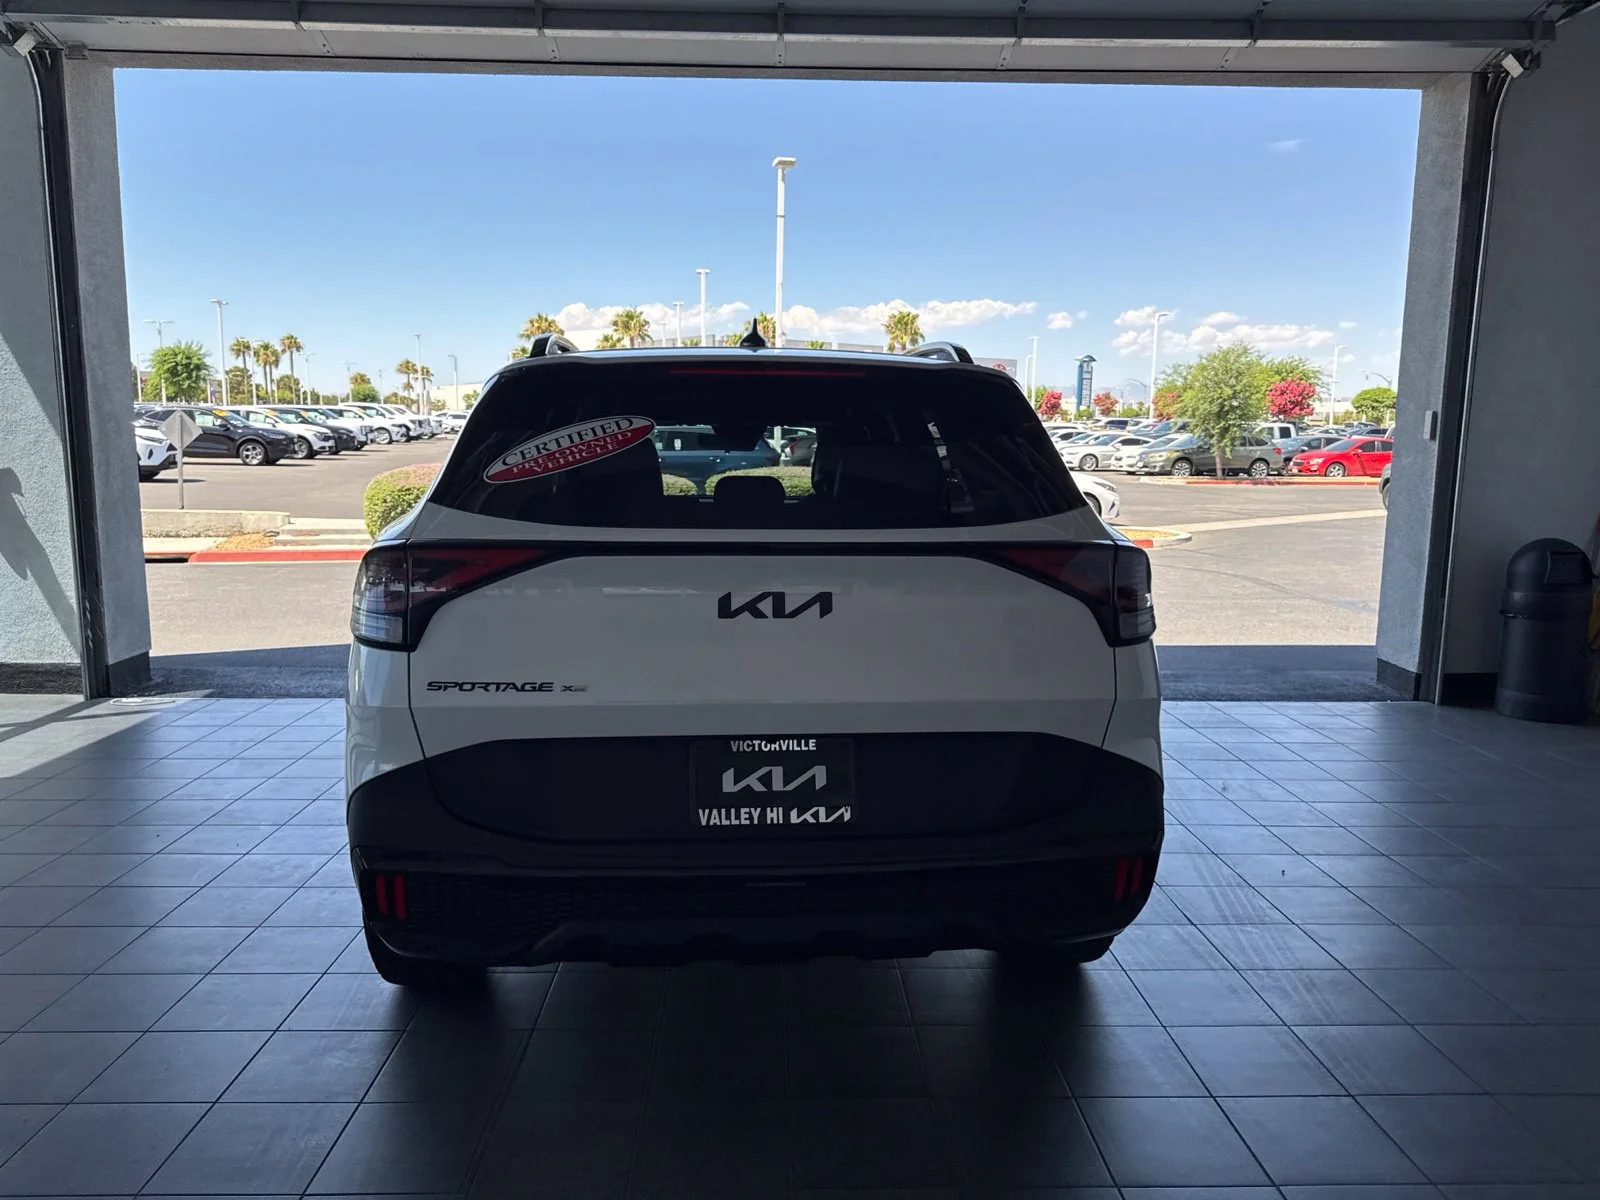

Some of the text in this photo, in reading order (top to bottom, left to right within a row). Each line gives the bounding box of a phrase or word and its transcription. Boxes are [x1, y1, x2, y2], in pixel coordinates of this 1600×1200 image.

[502, 417, 634, 467] CERTIFIED
[511, 431, 633, 474] PRE-OWNED
[531, 443, 619, 472] VEHICLE
[717, 591, 833, 619] KIA
[426, 681, 554, 693] SPORTAGE
[699, 807, 762, 826] VALLEY
[766, 807, 783, 824] HI
